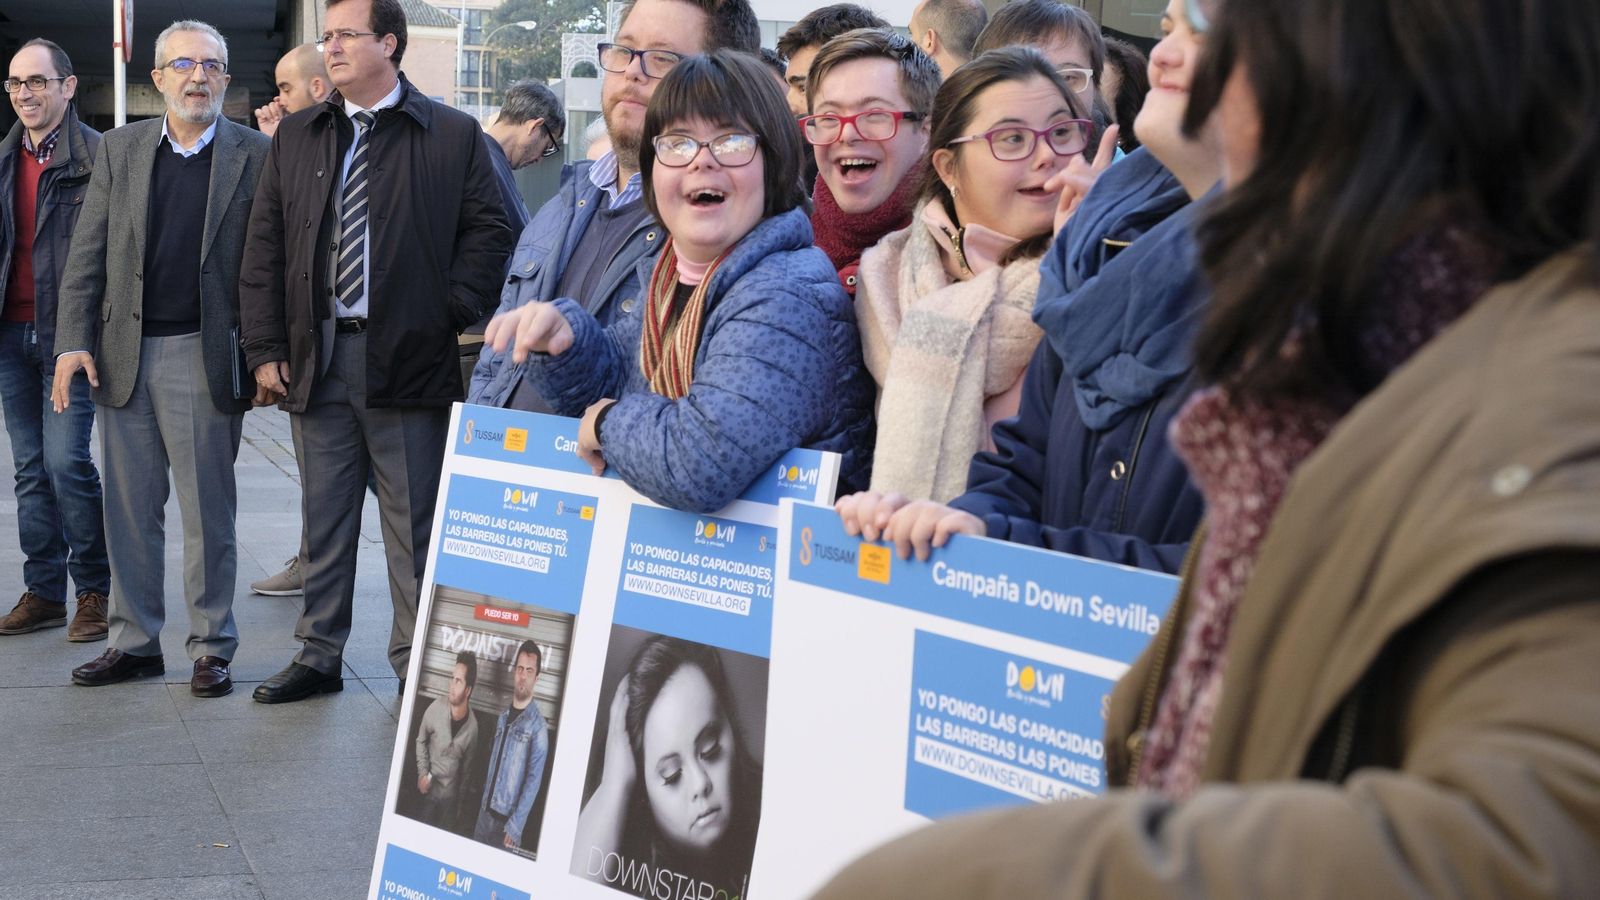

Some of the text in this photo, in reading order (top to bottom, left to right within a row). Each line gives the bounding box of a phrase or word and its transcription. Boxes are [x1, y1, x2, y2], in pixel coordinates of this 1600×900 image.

[474, 429, 504, 442] TUSSAM
[555, 435, 579, 453] Cam
[778, 464, 818, 485] DOWN
[503, 487, 538, 508] DOWN
[446, 524, 568, 557] LAS BARRERAS LAS PONES TÚ.
[448, 509, 568, 543] YO PONGO LAS CAPACIDADES,
[695, 519, 736, 544] DOWN
[446, 540, 546, 570] WWW.DOWNSEVILLA.ORG
[630, 542, 773, 583] YO PONGO LAS CAPACIDADES,
[813, 543, 857, 564] TUSSAM
[626, 559, 772, 599] LAS BARRERAS LAS PONES TÚ.
[628, 577, 747, 611] WWW.DOWNSEVILLA.ORG
[932, 561, 1160, 635] Campaña Down Sevilla
[1006, 661, 1065, 702] DOWN
[918, 688, 937, 709] YO
[938, 695, 987, 725] PONGO
[989, 710, 1017, 734] LAS
[1018, 719, 1105, 761] CAPACIDAD
[916, 714, 941, 737] LAS
[943, 722, 1016, 760] BARRERAS
[1018, 744, 1046, 770] LAS
[1049, 755, 1100, 787] PONES
[385, 880, 396, 893] YO
[438, 867, 472, 893] DOWN
[586, 846, 740, 900] DOWNSTAR
